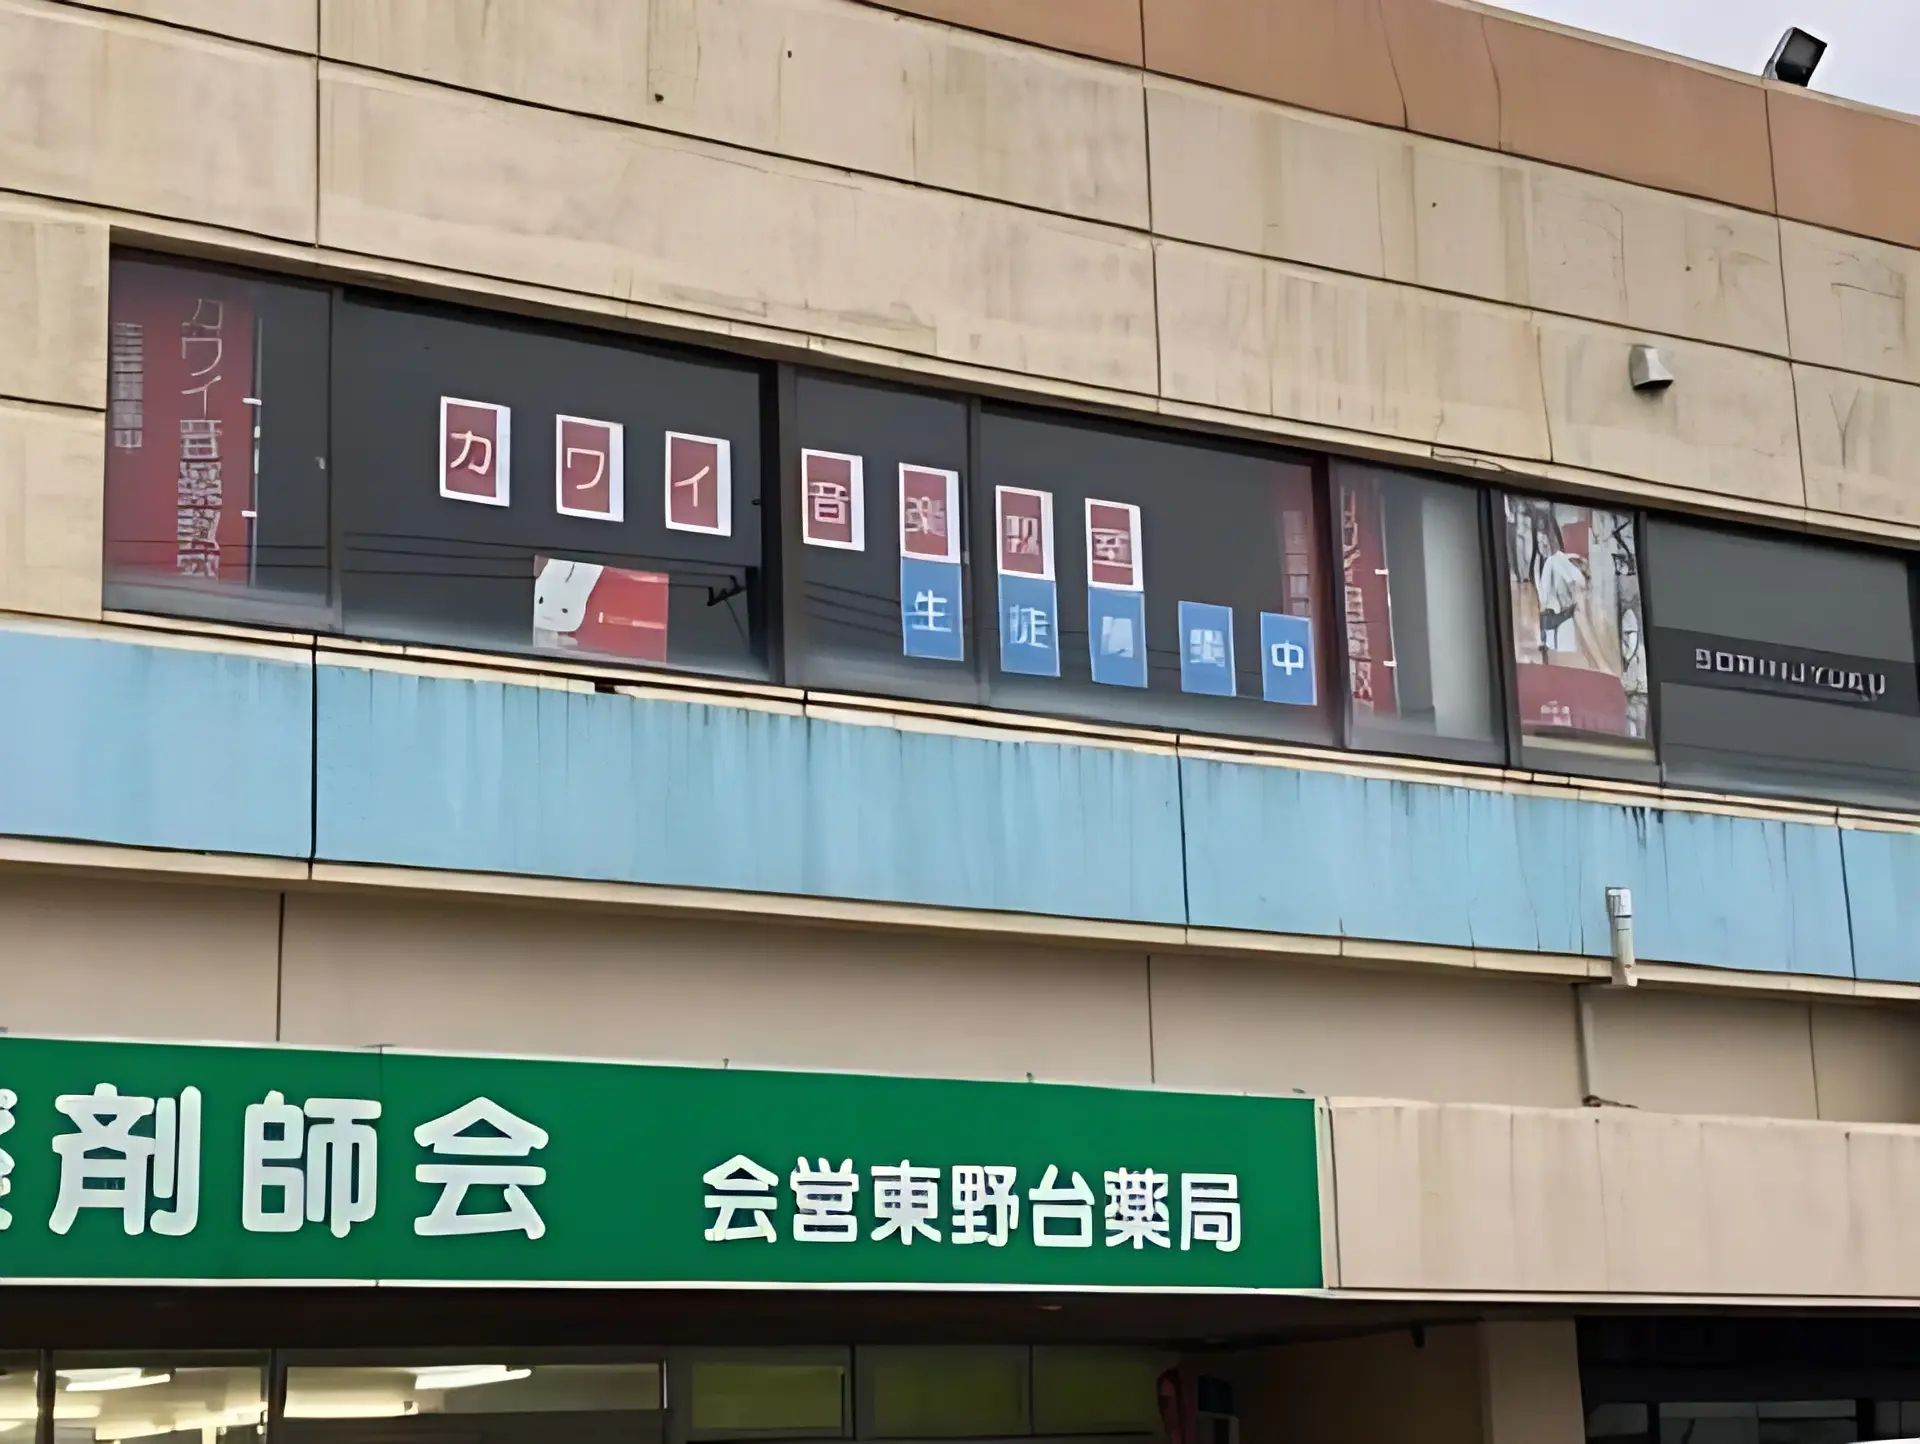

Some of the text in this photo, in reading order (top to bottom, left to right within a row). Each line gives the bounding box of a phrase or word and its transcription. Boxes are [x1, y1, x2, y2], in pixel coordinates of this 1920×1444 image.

[702, 1153, 1242, 1252] 会営東野台薬局
